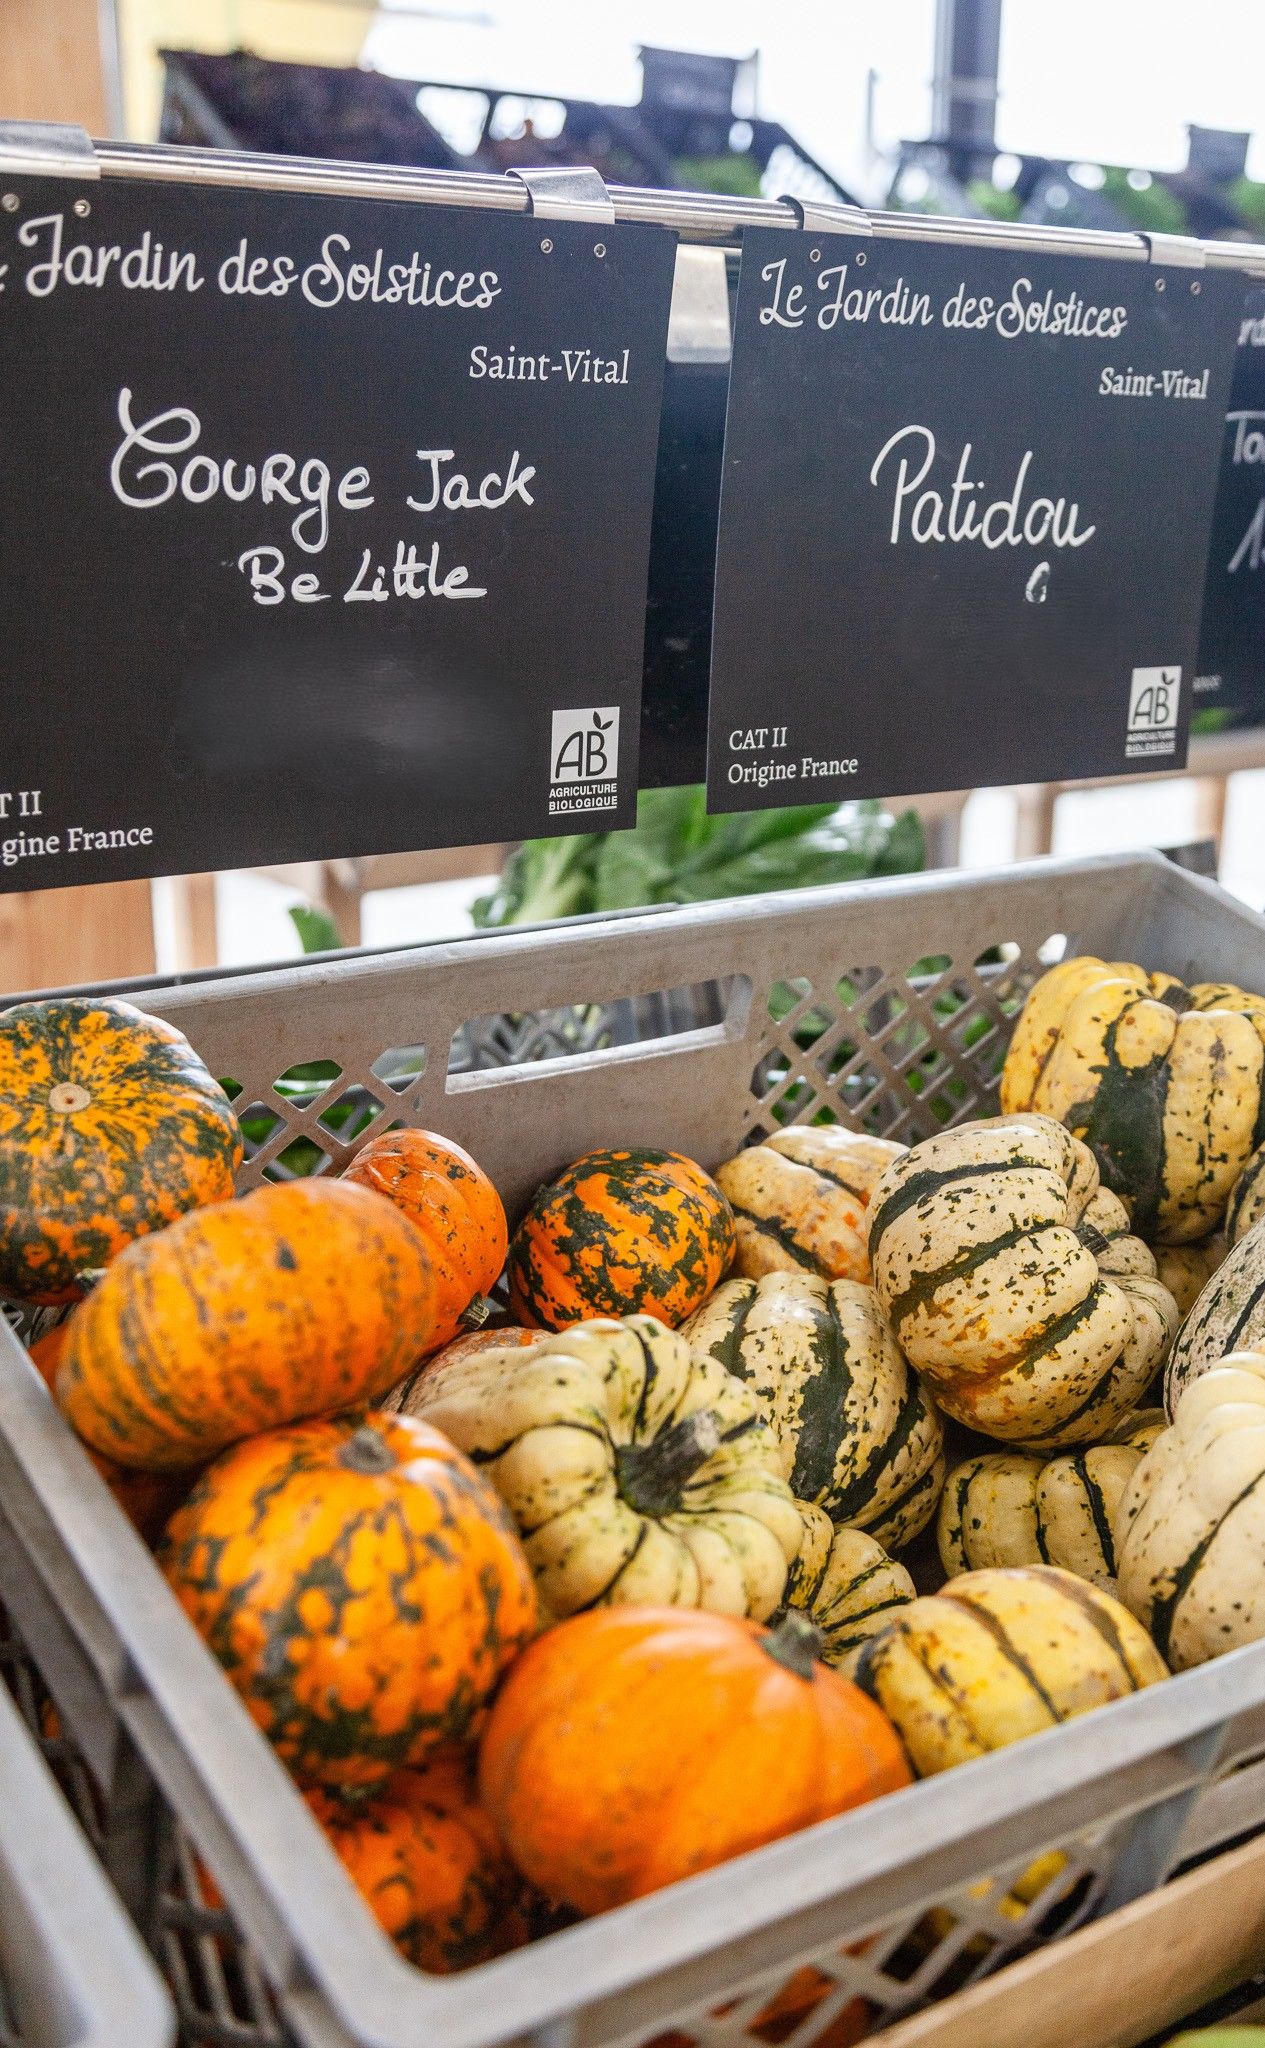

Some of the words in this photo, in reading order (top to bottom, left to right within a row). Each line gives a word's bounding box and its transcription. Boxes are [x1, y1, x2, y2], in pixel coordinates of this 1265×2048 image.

[19, 213, 204, 297] Jardin
[218, 238, 299, 297] des
[302, 234, 502, 308] Solstices
[759, 257, 808, 329] Le
[817, 265, 934, 330] Jardin
[942, 281, 996, 330] des
[996, 278, 1128, 338] Solstices
[469, 345, 630, 384] Saint-Vital
[1099, 366, 1211, 400] Saint-Vital
[406, 450, 536, 512] Jack
[870, 425, 1096, 549] Patidou
[238, 546, 332, 605] Be
[343, 540, 488, 603] Little
[1133, 686, 1170, 726] AB
[555, 731, 608, 779] AB
[728, 727, 769, 752] CAT
[771, 726, 789, 749] II
[548, 783, 618, 799] AGRICULTURE
[728, 761, 797, 788] Origine
[800, 757, 859, 778] France
[19, 790, 43, 817] II
[548, 796, 618, 811] BIOLOGIQUE
[67, 827, 153, 853] France
